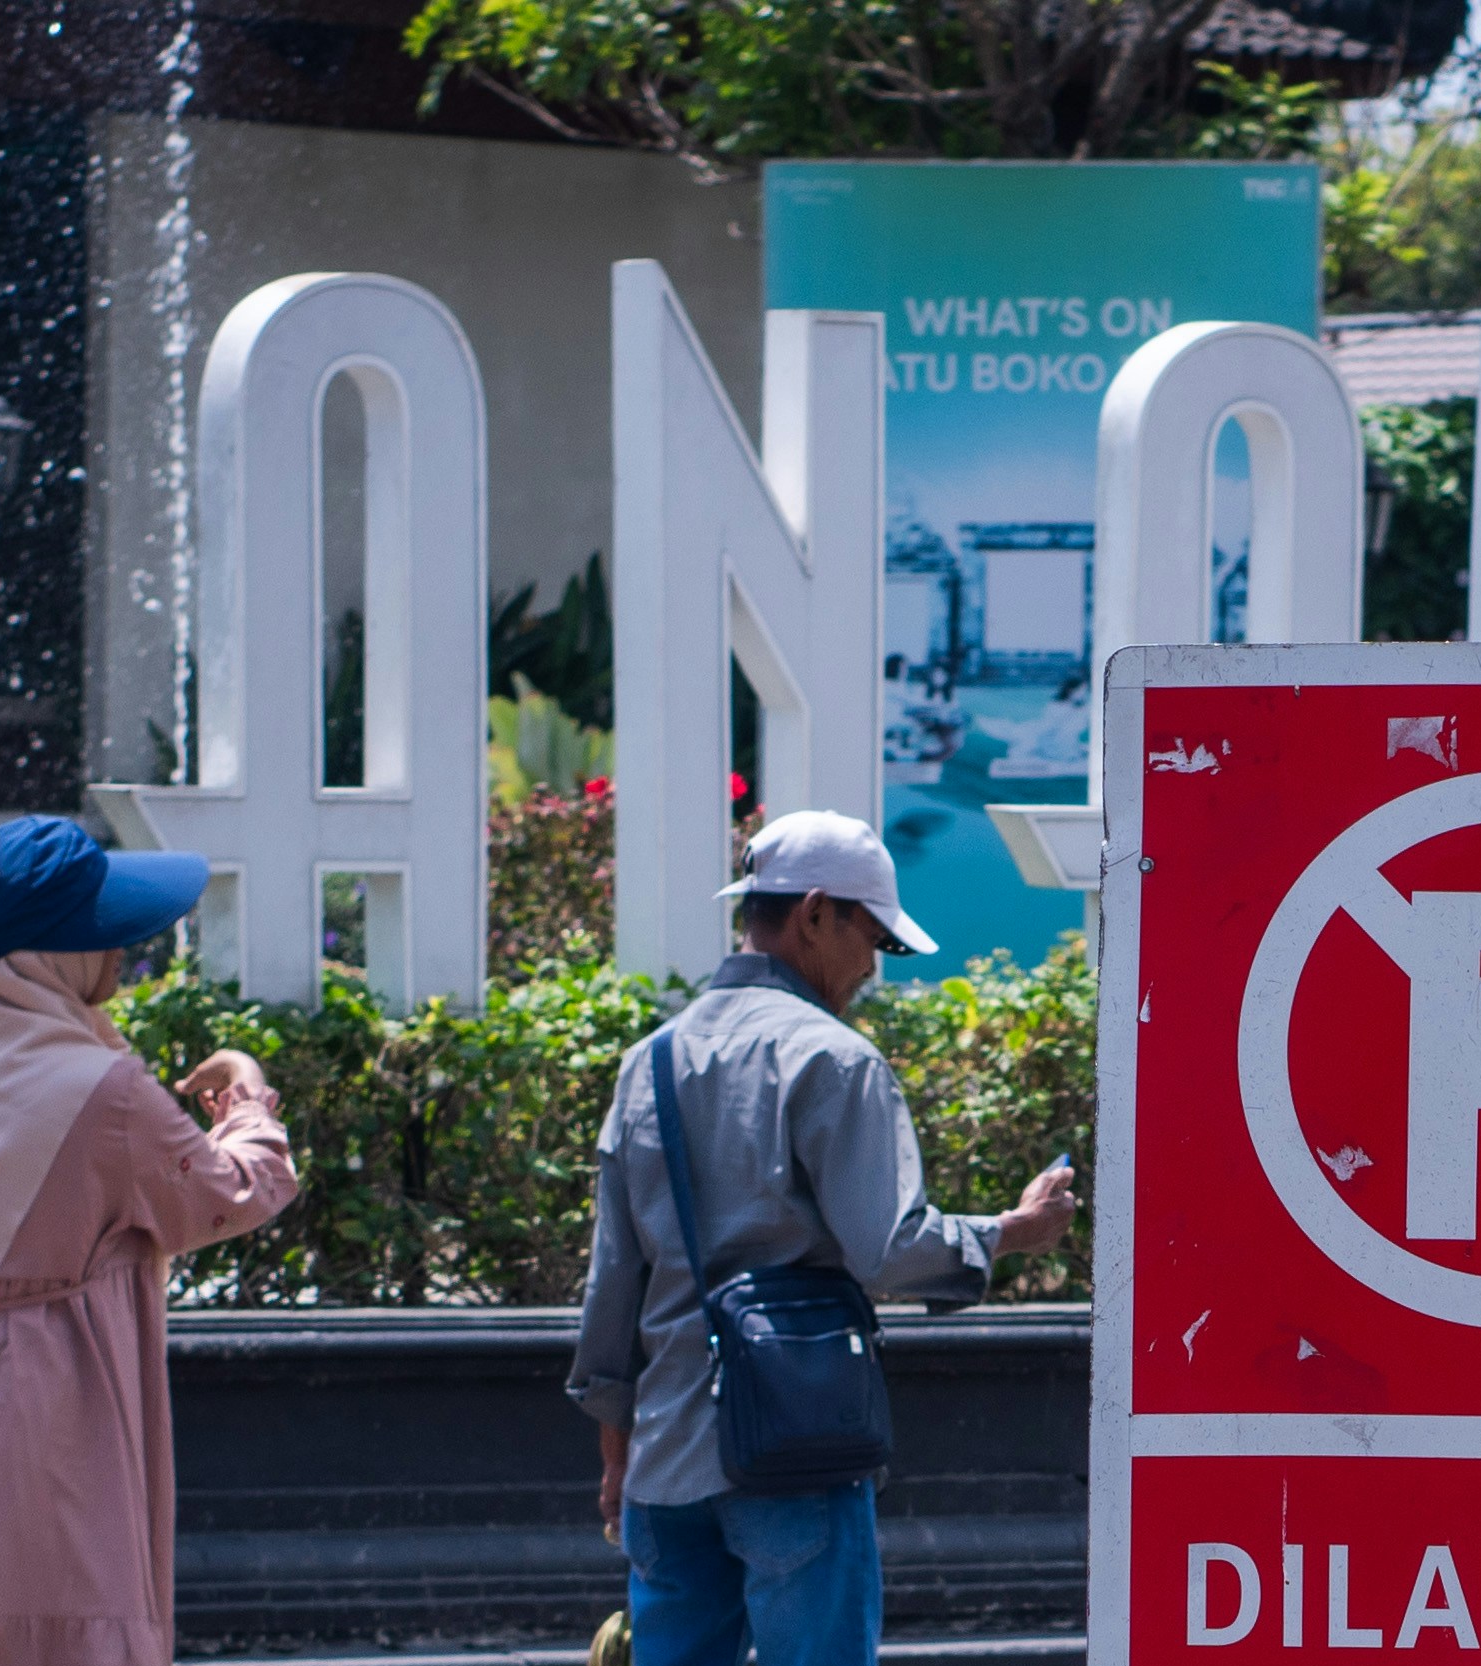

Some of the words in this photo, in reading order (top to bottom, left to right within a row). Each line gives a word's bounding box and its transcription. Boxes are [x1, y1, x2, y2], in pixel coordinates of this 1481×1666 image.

[904, 297, 1090, 337] WHAT'S
[1101, 297, 1173, 337] ON
[973, 353, 1106, 393] BOKO
